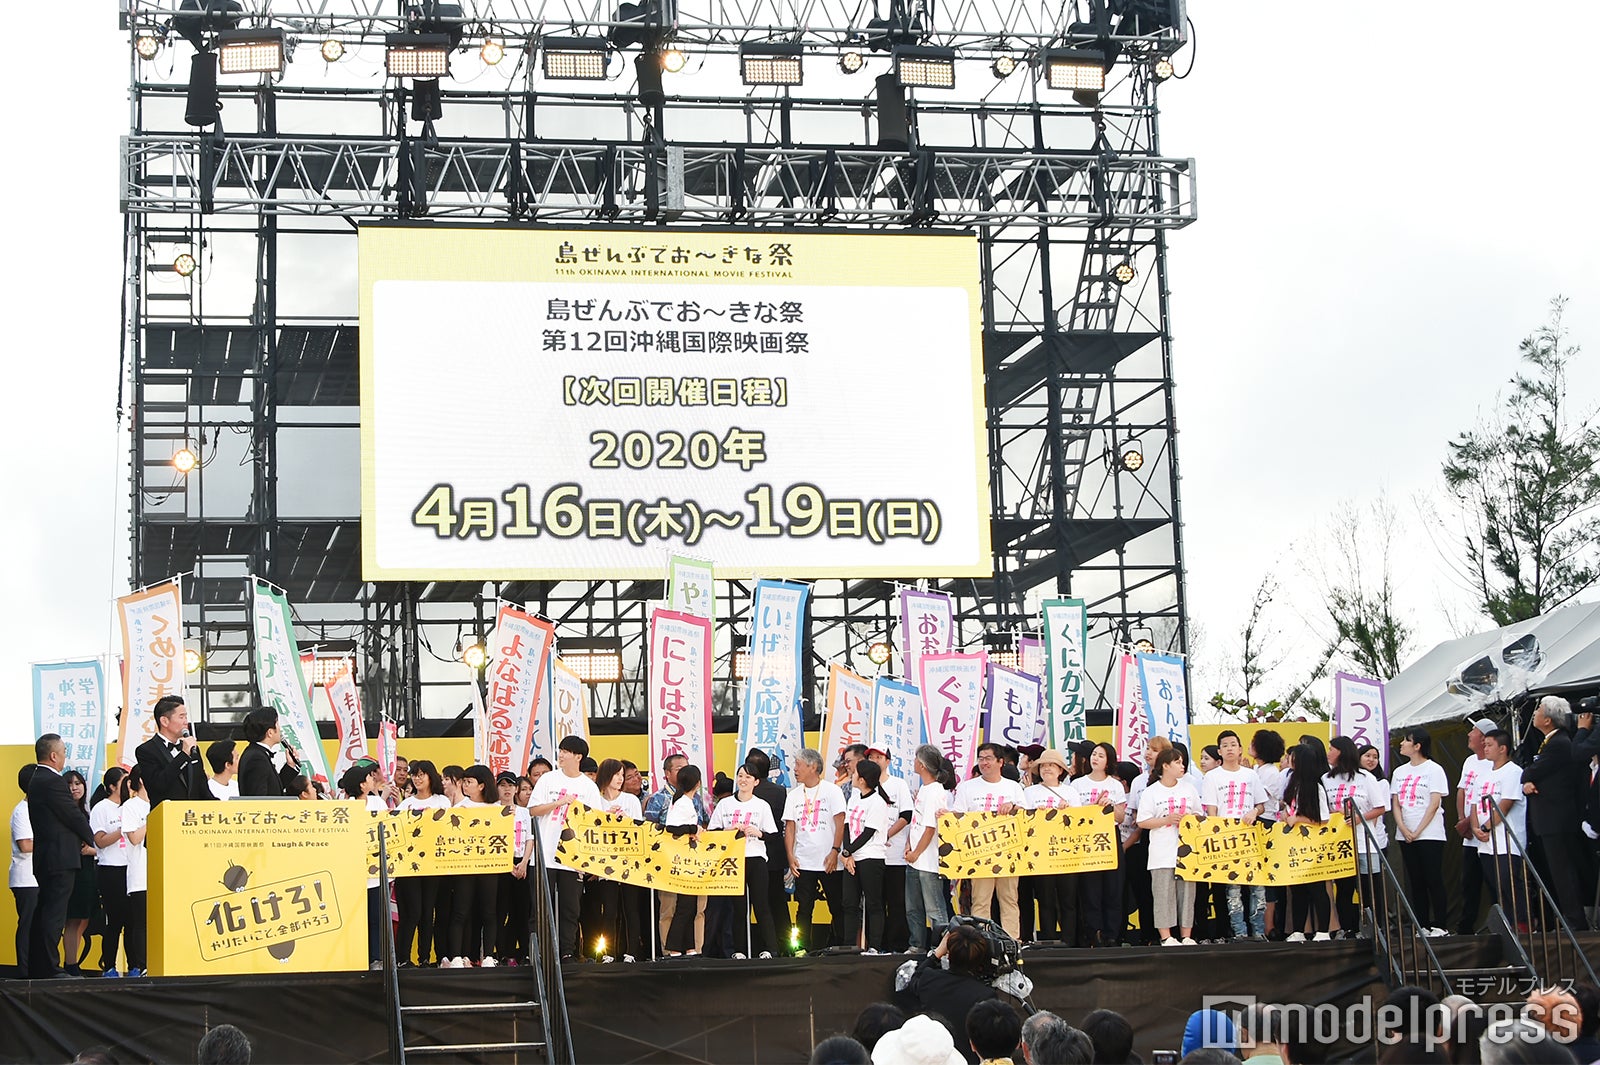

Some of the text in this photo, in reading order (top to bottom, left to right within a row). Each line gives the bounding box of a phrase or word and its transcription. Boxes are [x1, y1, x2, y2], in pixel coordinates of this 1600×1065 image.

[631, 269, 709, 277] INTERNATIONAL
[714, 270, 745, 278] MOVIE
[542, 329, 809, 354] 第12回沖縄国際映画祭
[563, 375, 788, 407] 【次回開催日程】
[589, 427, 767, 470] 2020年
[680, 582, 700, 615] や
